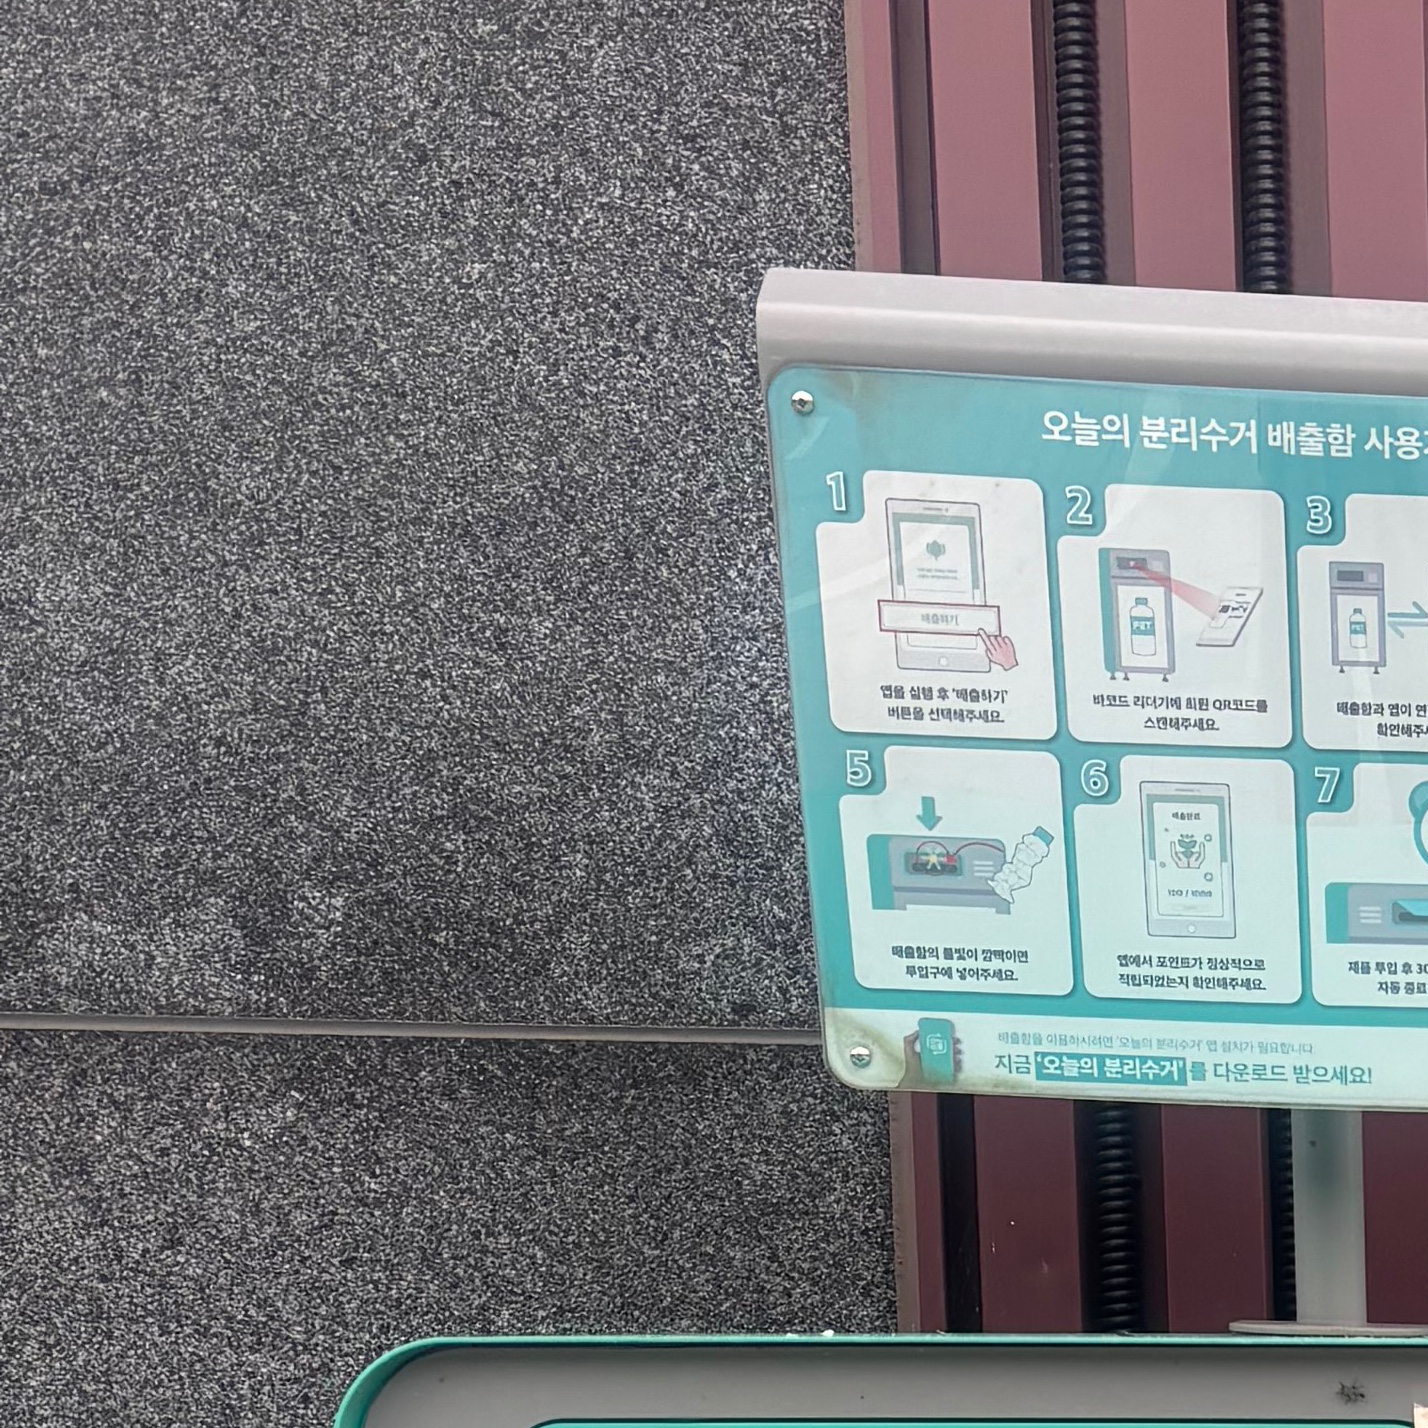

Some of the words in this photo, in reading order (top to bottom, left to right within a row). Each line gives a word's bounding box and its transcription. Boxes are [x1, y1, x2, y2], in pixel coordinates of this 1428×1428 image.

[1042, 410, 1130, 447] 오늘의
[1139, 416, 1257, 454] 분리수거
[1268, 422, 1354, 457] 배출함
[826, 471, 846, 511] 1
[1066, 486, 1092, 525] 2
[1306, 496, 1332, 534] 3
[1133, 621, 1152, 630] PET
[880, 685, 905, 700] 앱을
[910, 686, 933, 701] 실행
[937, 688, 949, 701] 후
[1093, 694, 1129, 707] 바코드
[1213, 699, 1268, 712] QR코드를
[1337, 702, 1384, 716] 배출함과
[1388, 703, 1411, 716] 앱이
[888, 707, 924, 720] 버튼을
[929, 708, 1004, 723] 선택해주세요.
[1144, 717, 1219, 731] 스캔해주세요.
[846, 749, 872, 787] 5
[1081, 760, 1109, 796] 6
[1314, 767, 1340, 804] 7
[892, 945, 939, 960] 배출함의
[943, 947, 977, 961] 불빛이
[1117, 954, 1152, 968] 앱에서
[1157, 955, 1203, 969] 포인트가
[1207, 957, 1265, 971] 정상적으로
[1348, 961, 1371, 975] 제품
[1375, 962, 1397, 975] 투입
[1401, 962, 1413, 975] 후
[906, 965, 952, 979] 투입구에
[957, 967, 1018, 981] 넣어주세요.
[1119, 974, 1189, 989] 적립되었는지
[1193, 976, 1266, 990] 확인해주세요.
[1378, 981, 1400, 995] 자동
[1206, 1040, 1217, 1051] 앱
[995, 1055, 1030, 1074] 지금
[1037, 1055, 1098, 1077] '오늘의
[1214, 1062, 1288, 1082] 다운로드
[1293, 1064, 1372, 1085] 받으세요!
